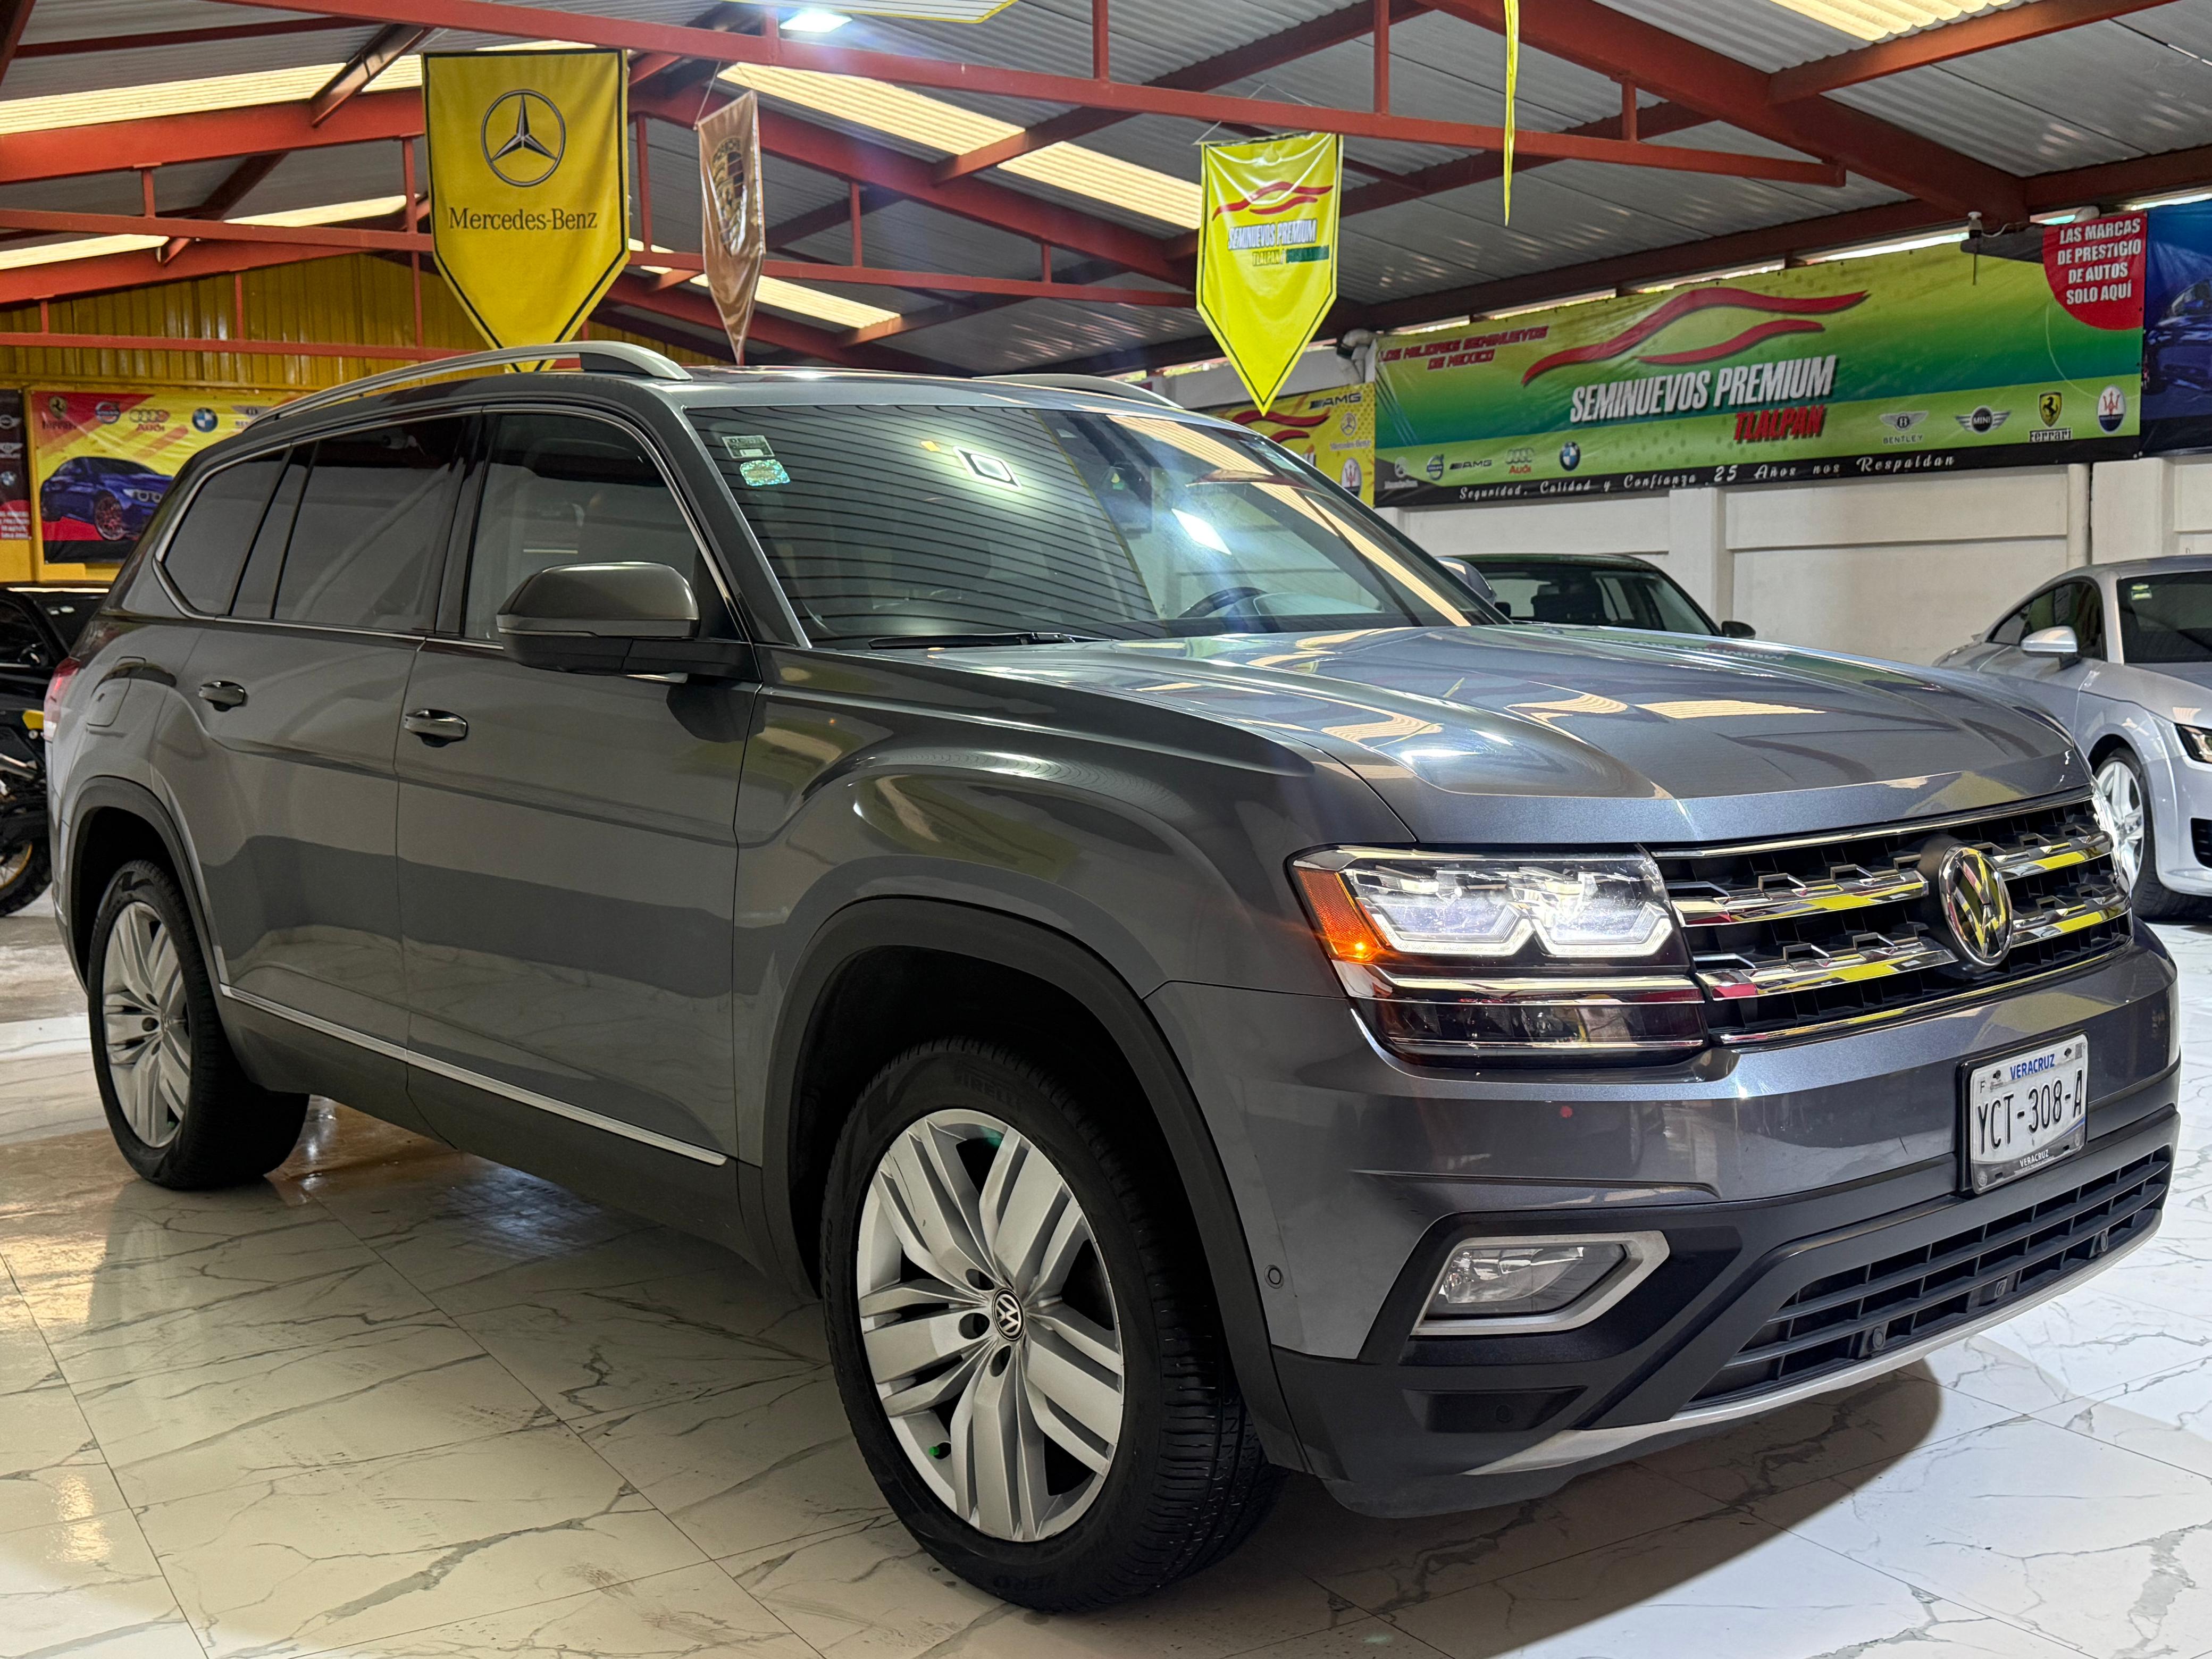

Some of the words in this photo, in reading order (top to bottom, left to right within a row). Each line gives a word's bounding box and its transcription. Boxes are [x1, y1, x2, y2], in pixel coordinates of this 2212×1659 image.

[449, 207, 597, 230] Mercedes-Benz
[1228, 222, 1276, 250] SEMINUEVOS
[1277, 218, 1317, 246] PREMIUM
[2059, 227, 2082, 245] LAS
[2084, 218, 2141, 240] MARCAS
[2058, 249, 2072, 265] DE
[2075, 239, 2141, 263] PRESTIGIO
[2068, 269, 2084, 284] DE
[2085, 262, 2128, 282] AUTOS
[2066, 287, 2098, 305] SOLO
[2100, 279, 2132, 301] AQUÍ
[1378, 348, 1402, 363] LOS
[1427, 357, 1445, 370] DE
[1322, 393, 1362, 407] AMG
[1570, 370, 1711, 423] SEMINUEVOS
[1713, 355, 1837, 408] PREMIUM
[1733, 404, 1826, 443] TLALPAN
[1973, 416, 1991, 424] MINI
[1883, 434, 1923, 445] BENTLEY
[2029, 428, 2072, 443] Ferrari
[1463, 459, 1492, 468] AMG
[1509, 464, 1531, 474] Audi
[1539, 479, 1591, 495] Calidad
[1603, 480, 1611, 492] y
[1714, 464, 1738, 482] 25
[1754, 464, 1797, 480] Años
[1813, 464, 1840, 475] nos
[1856, 454, 1956, 472] Respaldan
[2010, 1053, 2055, 1080] VERACRUZ
[1978, 1069, 2083, 1155] YCT-308-A
[2019, 1149, 2049, 1168] VERACRUZ
